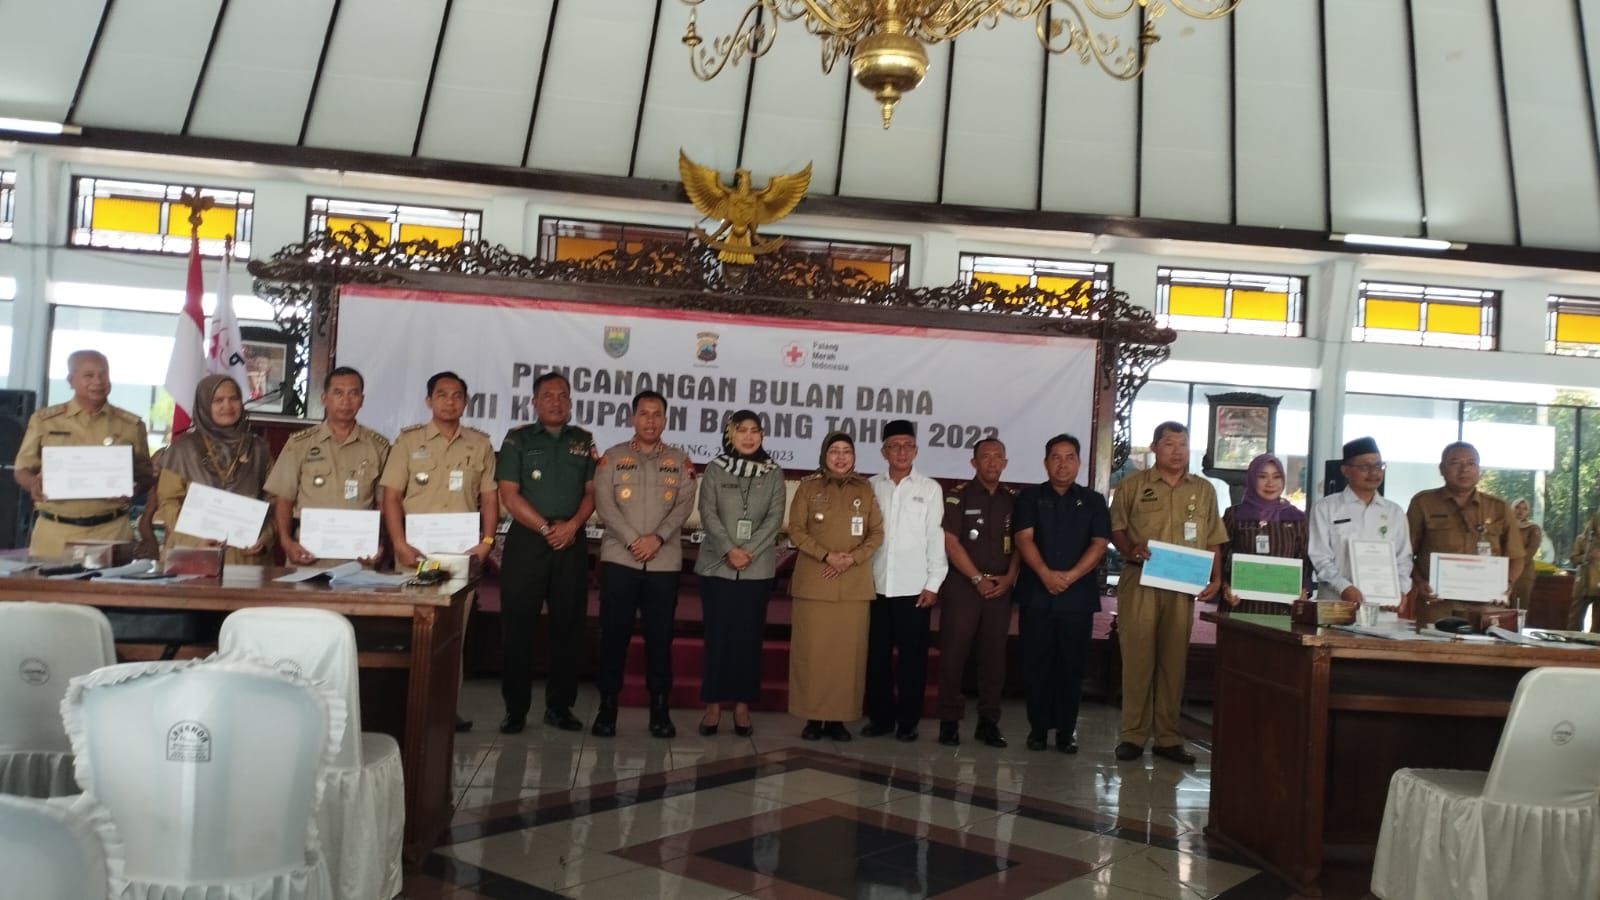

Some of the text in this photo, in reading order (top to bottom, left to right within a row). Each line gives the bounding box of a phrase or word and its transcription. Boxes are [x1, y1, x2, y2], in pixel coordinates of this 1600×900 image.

[466, 393, 498, 419] MI
[511, 396, 688, 432] KUPAN
[700, 408, 813, 439] BAANG
[825, 416, 918, 444] TAH
[749, 379, 844, 410] BULAN
[856, 387, 933, 415] DANA
